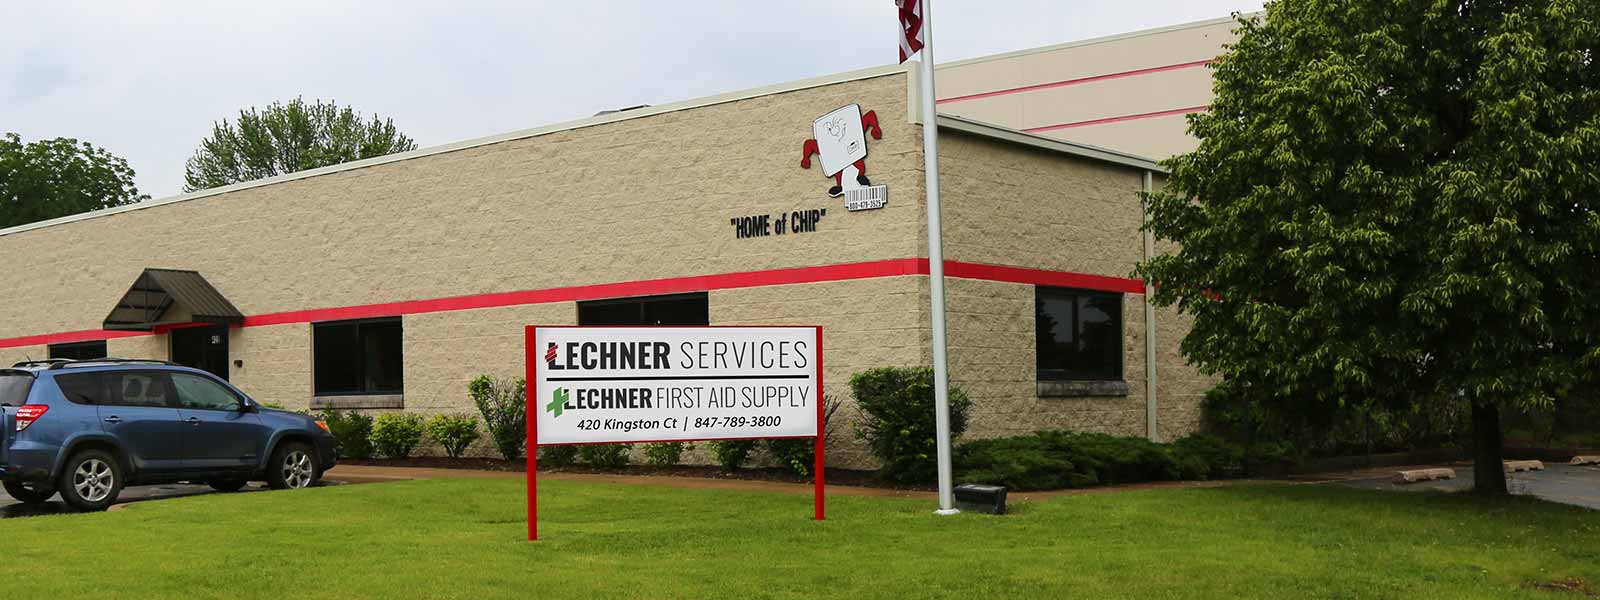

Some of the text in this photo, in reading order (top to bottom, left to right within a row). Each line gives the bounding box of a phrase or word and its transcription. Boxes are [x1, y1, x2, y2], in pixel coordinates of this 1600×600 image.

[730, 208, 827, 239] "HOME of CHIP"
[547, 340, 808, 370] LECHNER SERVICES
[563, 385, 810, 410] LECHNER FIRST AID SUPPLY
[577, 419, 601, 430] 420
[603, 418, 660, 433] Kingston
[663, 417, 678, 429] Ct
[694, 415, 782, 428] 847-789-3800
